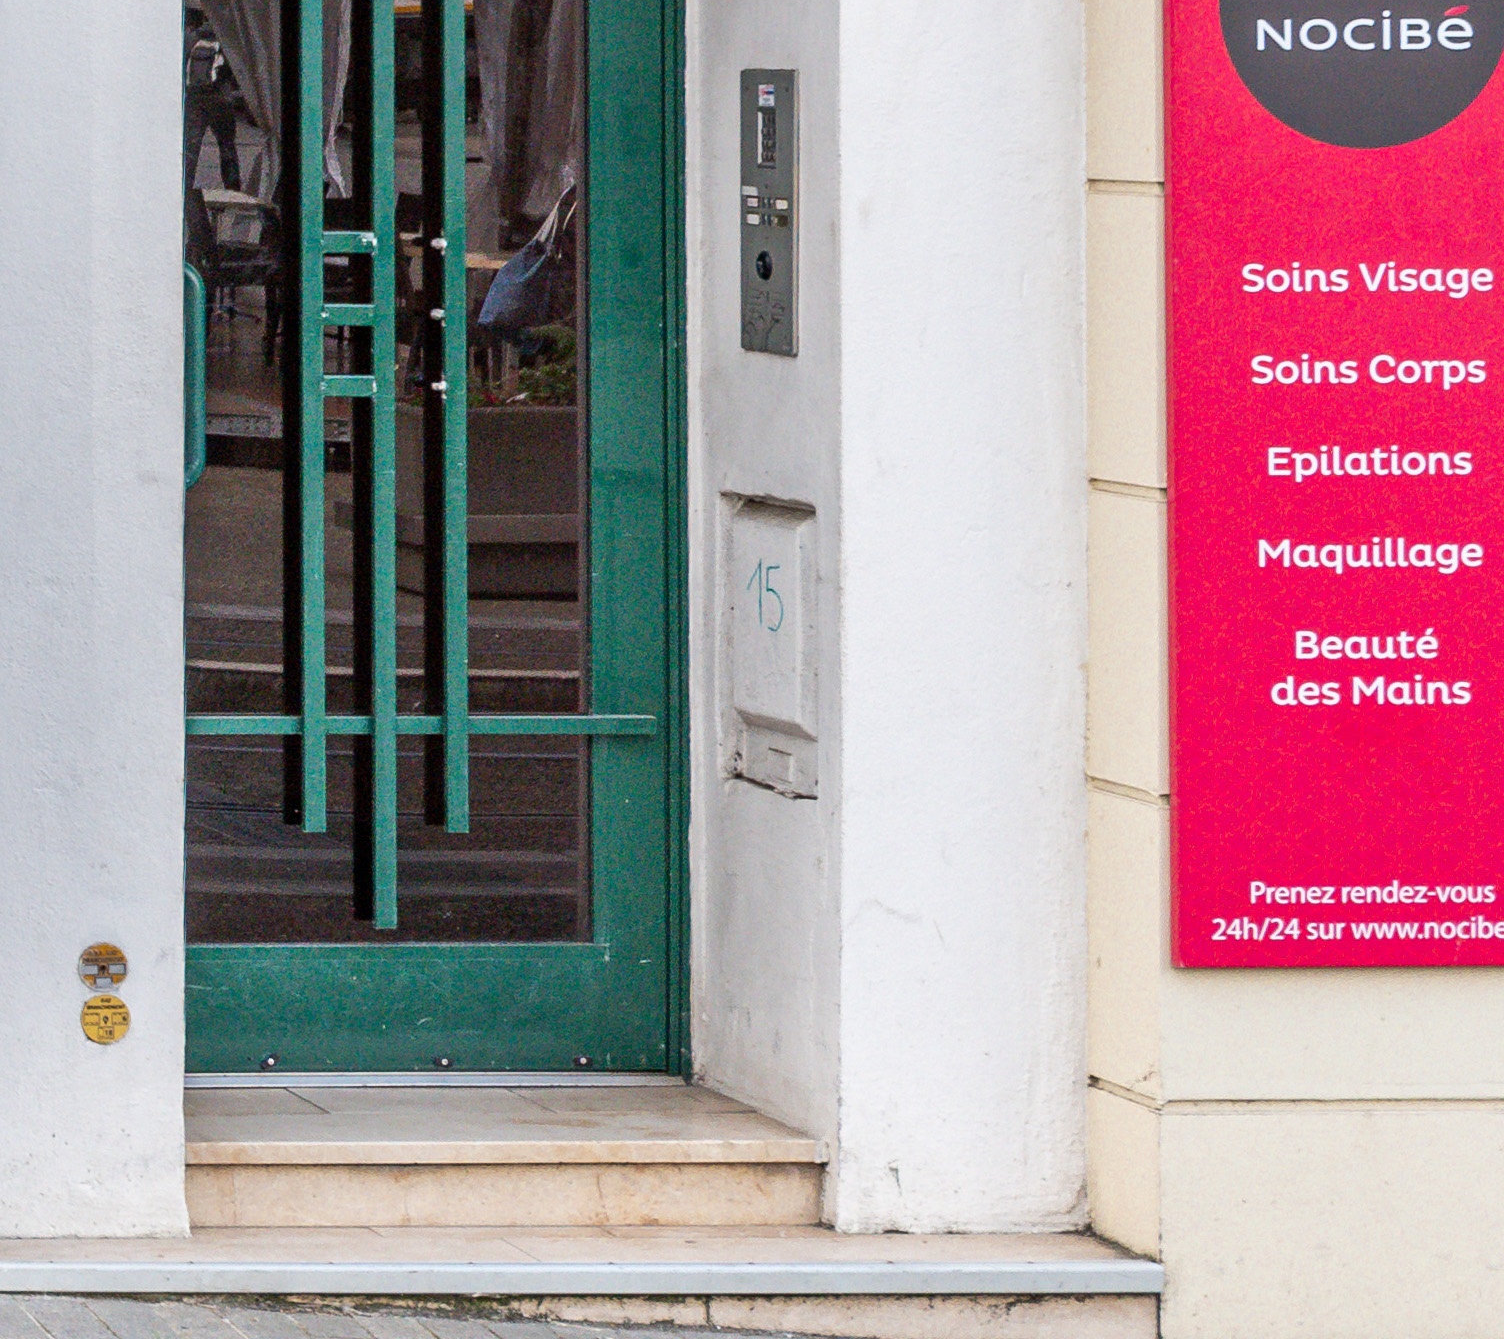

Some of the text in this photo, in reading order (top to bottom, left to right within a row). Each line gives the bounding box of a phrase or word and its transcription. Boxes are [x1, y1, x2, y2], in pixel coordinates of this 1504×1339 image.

[1241, 261, 1494, 299] Soins Visage
[1251, 353, 1487, 391] Soins Corps
[1267, 444, 1473, 483] Epilations
[1258, 536, 1484, 575] Maquillage
[746, 557, 785, 632] 15
[1295, 627, 1439, 660] Beauté
[1270, 674, 1472, 706] des Mains
[1250, 879, 1496, 905] Prenez rendez-vous
[1211, 916, 1301, 941] 24h/24
[1306, 922, 1346, 941] sur
